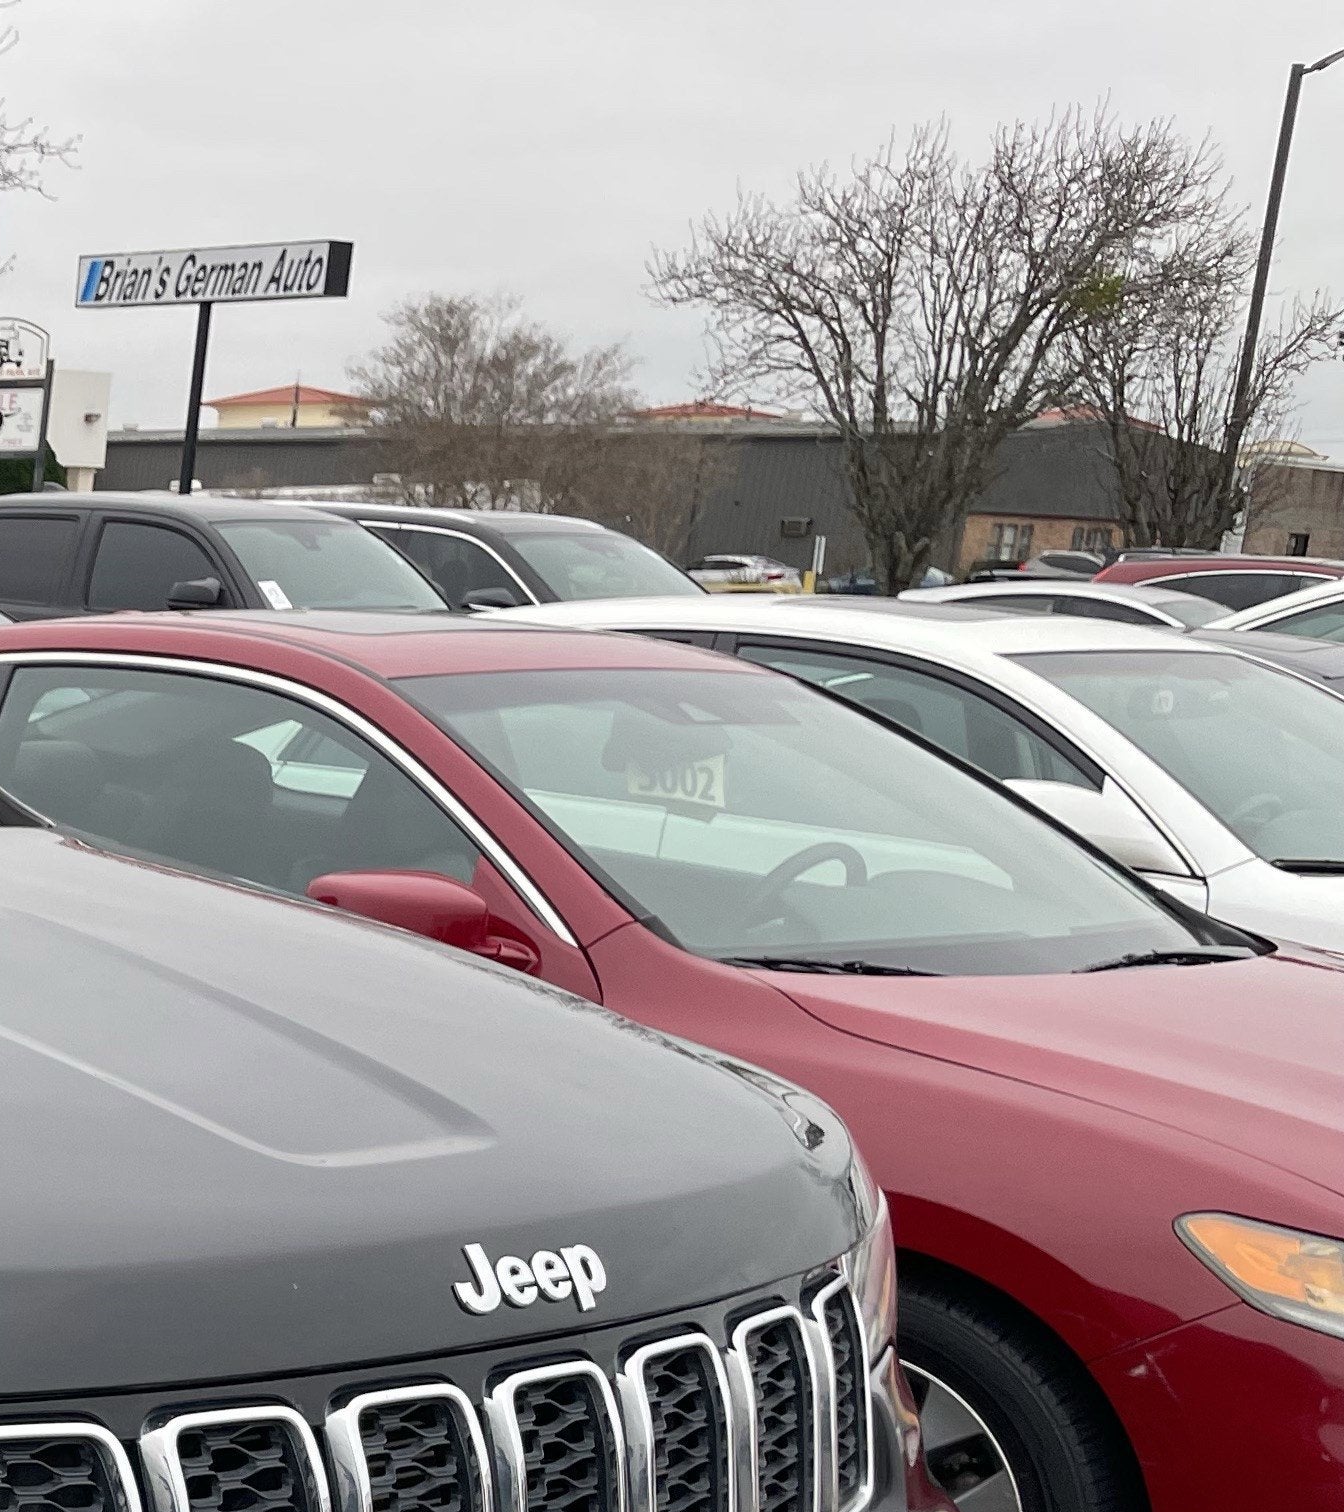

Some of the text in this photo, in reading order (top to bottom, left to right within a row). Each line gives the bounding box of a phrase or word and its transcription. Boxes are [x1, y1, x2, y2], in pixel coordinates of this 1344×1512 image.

[95, 248, 324, 301] Brian's German Auto
[451, 1243, 607, 1315] Jeep
